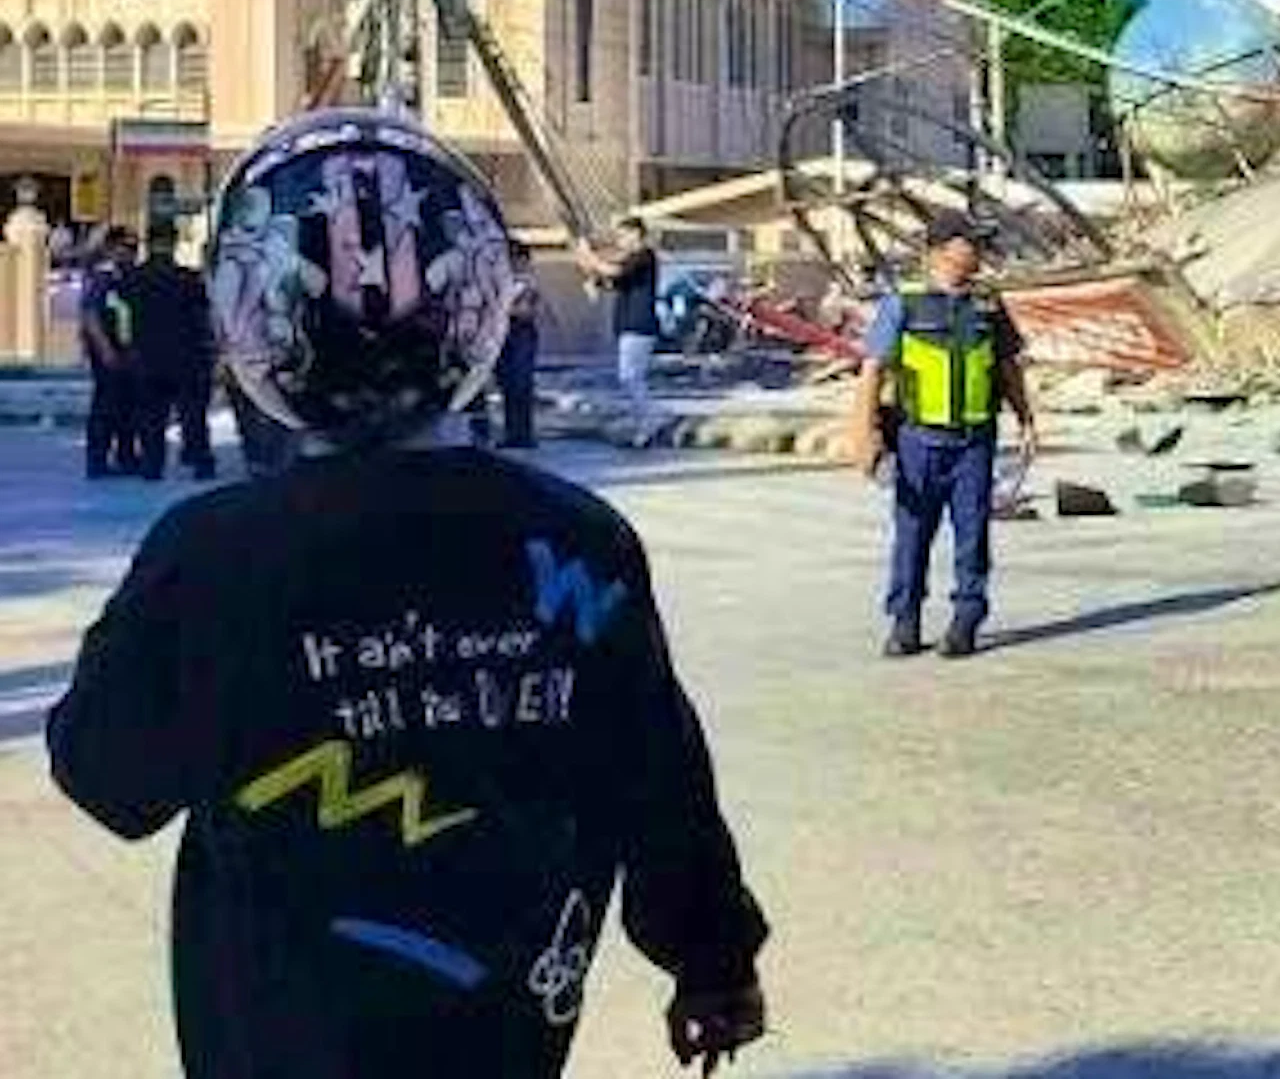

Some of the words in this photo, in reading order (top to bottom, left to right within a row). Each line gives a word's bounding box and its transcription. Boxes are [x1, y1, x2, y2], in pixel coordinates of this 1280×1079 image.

[303, 631, 343, 681] It
[357, 609, 441, 669] ain't
[456, 629, 540, 660] over
